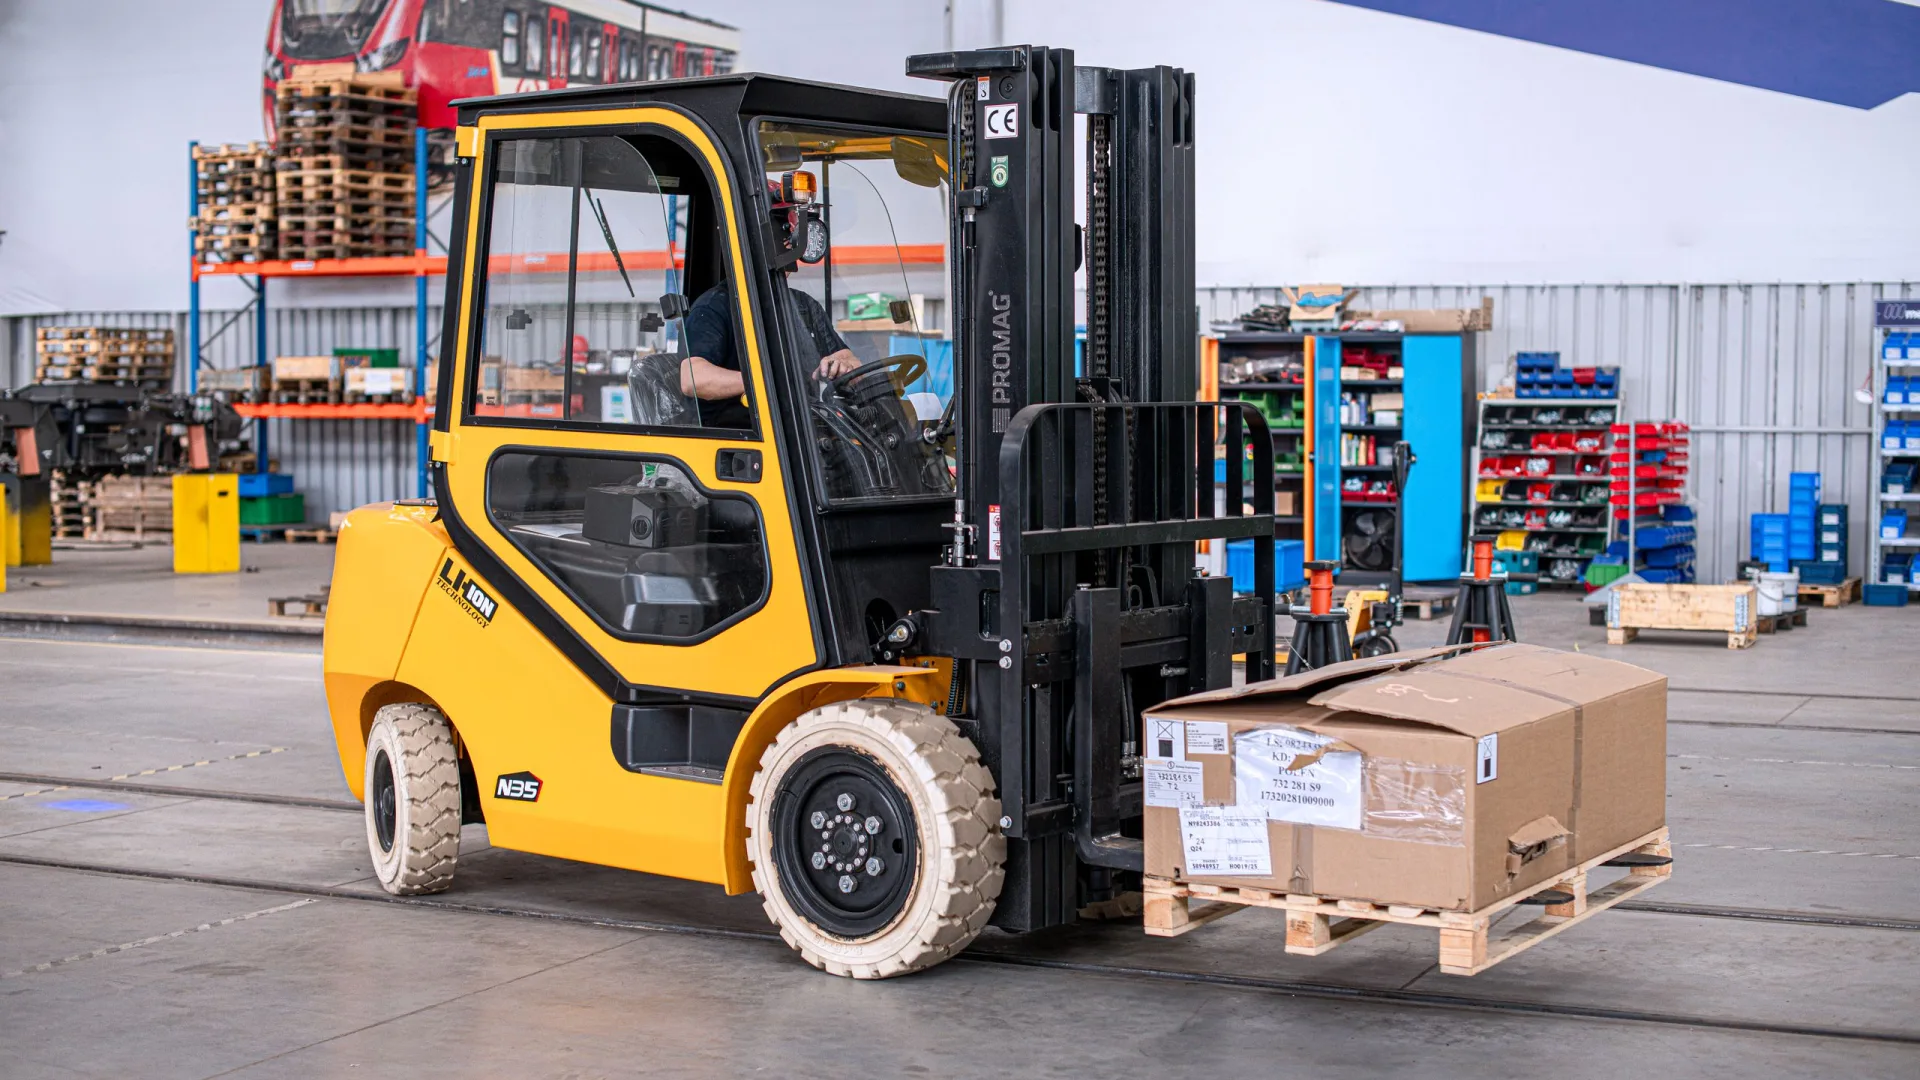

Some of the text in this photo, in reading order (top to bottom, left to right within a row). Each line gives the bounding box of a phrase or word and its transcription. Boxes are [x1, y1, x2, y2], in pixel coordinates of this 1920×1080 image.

[987, 108, 1015, 134] CE
[436, 577, 489, 629] TECHNOLOGY
[1272, 751, 1291, 762] KD:
[497, 778, 539, 799] N35
[1273, 778, 1322, 791] 732 281 S9
[1260, 791, 1335, 807] 17320281009000
